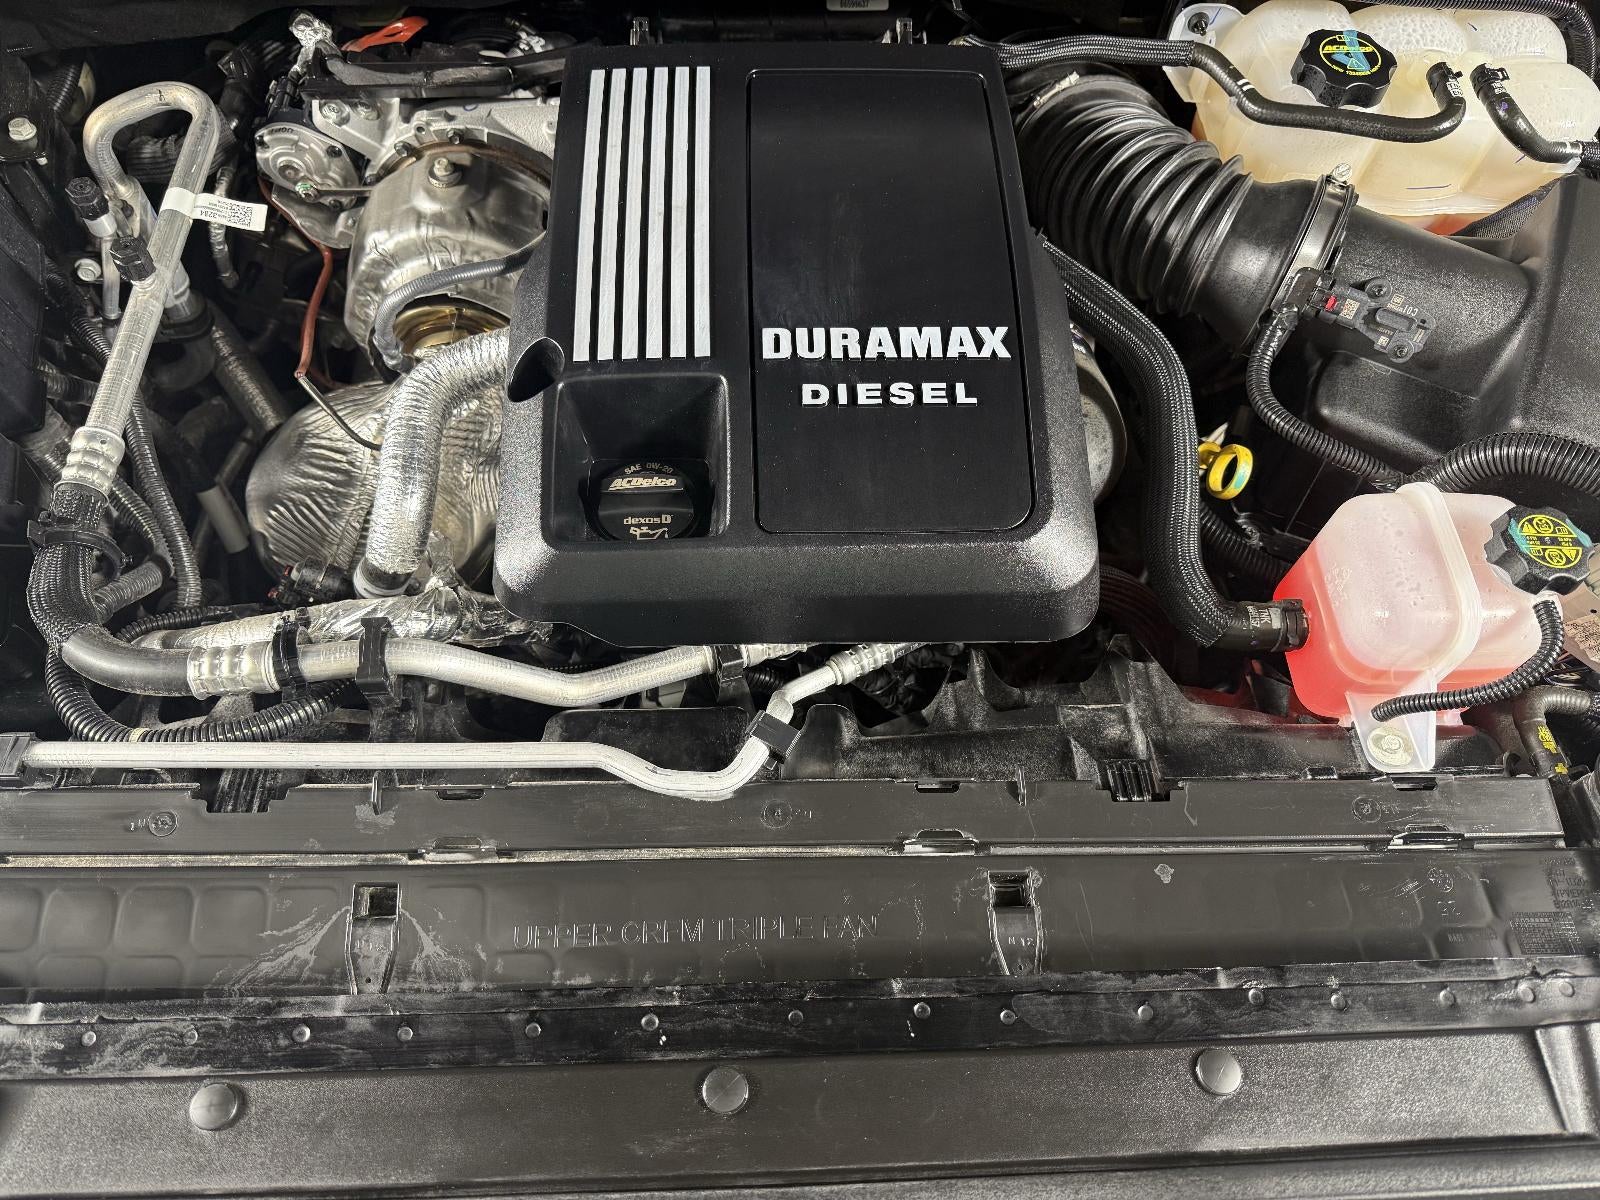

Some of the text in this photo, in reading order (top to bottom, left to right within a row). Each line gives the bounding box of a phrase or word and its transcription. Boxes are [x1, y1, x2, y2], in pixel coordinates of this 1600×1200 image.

[762, 326, 1011, 360] DURAMAX
[801, 382, 977, 406] DIESEL
[624, 463, 642, 475] SAE
[513, 914, 878, 949] UPPER CRFM TRIPLE FAN
